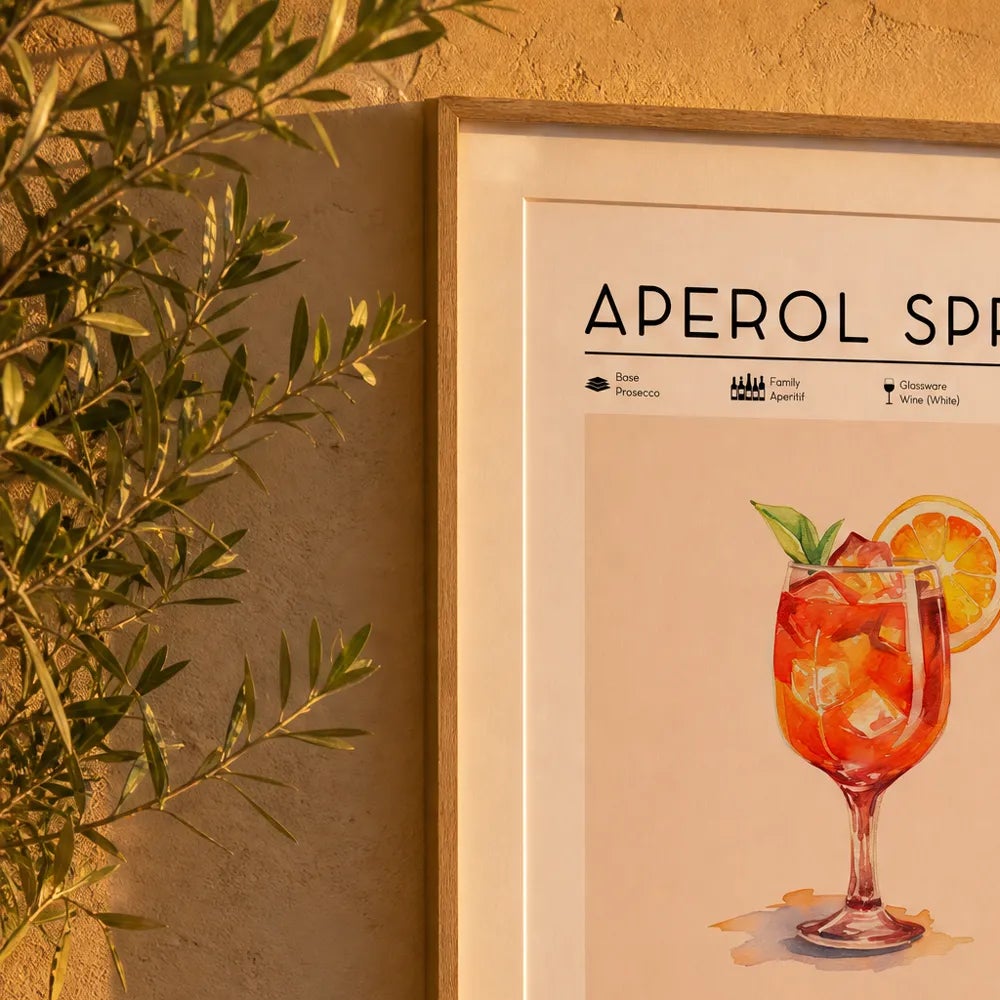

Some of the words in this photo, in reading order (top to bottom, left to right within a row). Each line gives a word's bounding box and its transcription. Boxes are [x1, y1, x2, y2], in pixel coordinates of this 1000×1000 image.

[584, 283, 869, 344] APEROL
[615, 372, 640, 384] Base
[769, 377, 801, 390] Family
[615, 386, 661, 398] Prosecco
[899, 380, 948, 392] Glassware
[769, 391, 806, 404] Aperitif
[899, 394, 924, 405] Wine
[926, 394, 961, 407] (White)
